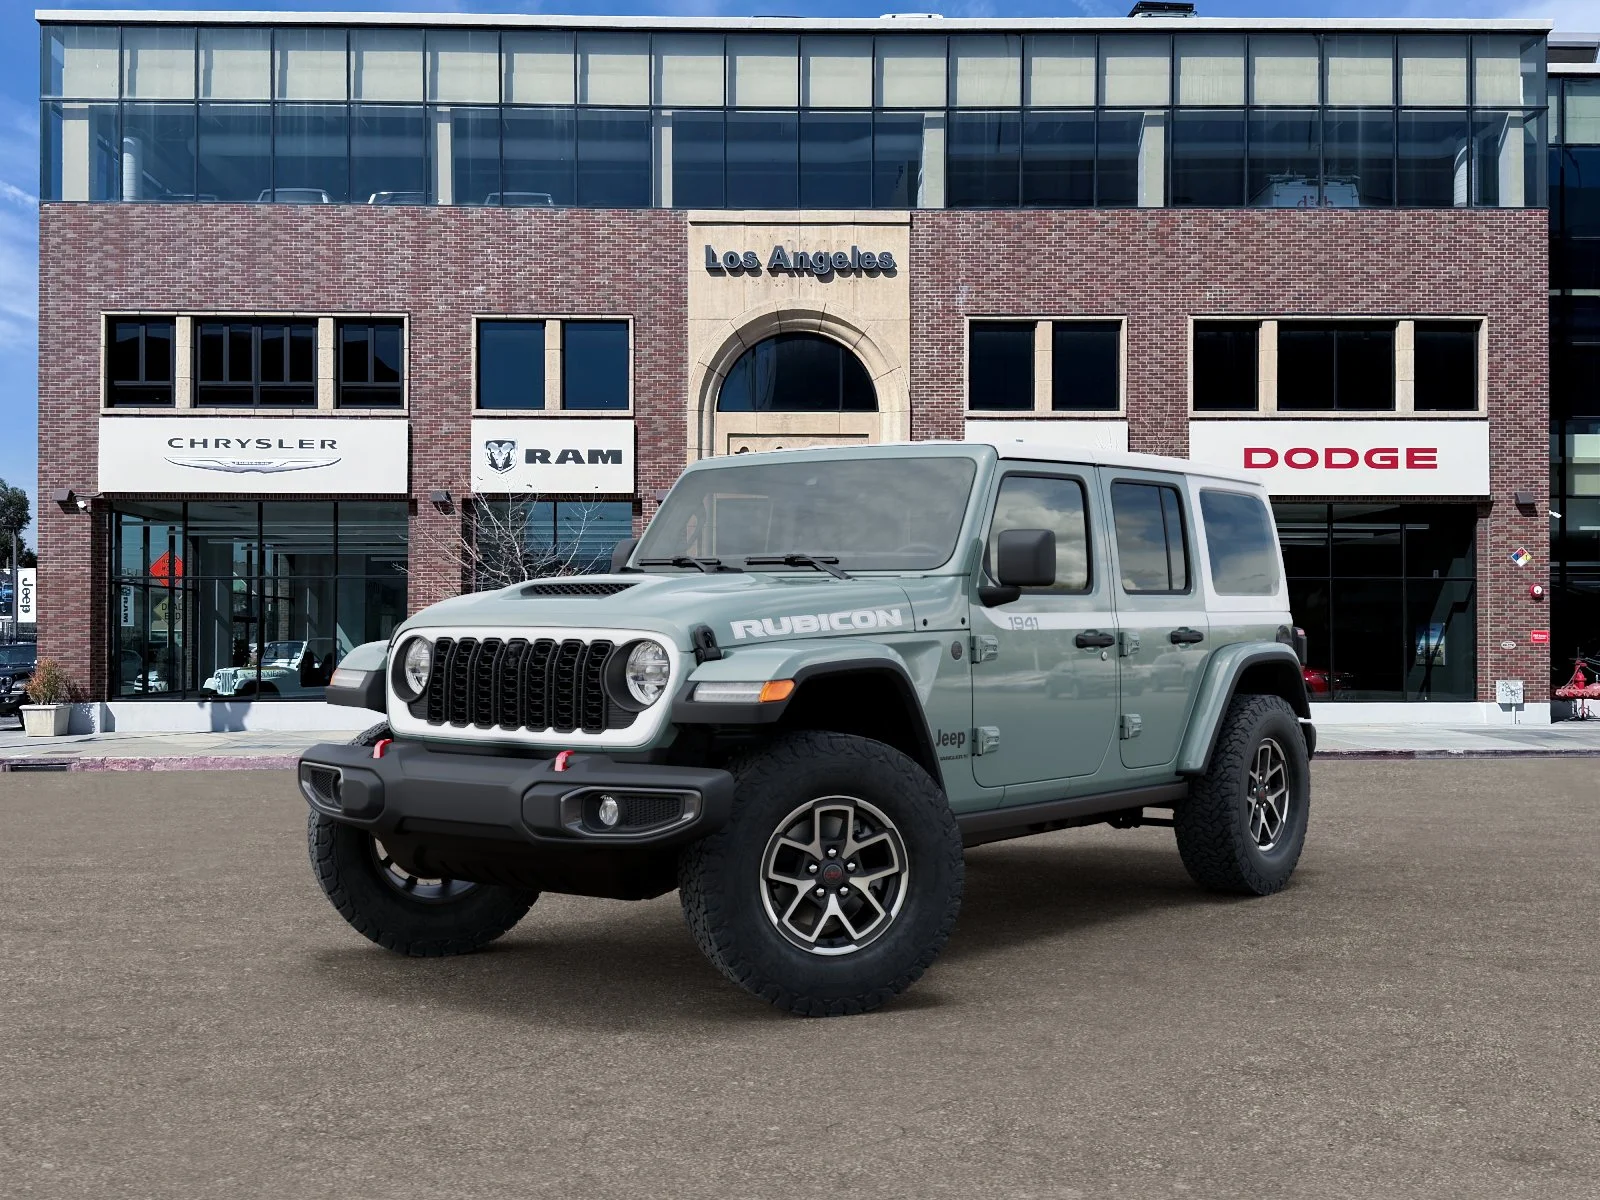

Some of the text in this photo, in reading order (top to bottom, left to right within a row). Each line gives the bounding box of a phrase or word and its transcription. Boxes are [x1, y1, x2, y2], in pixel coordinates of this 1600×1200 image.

[704, 245, 895, 275] Los Angeles
[167, 437, 338, 450] CHRYSLER
[525, 449, 623, 465] RAM
[1243, 447, 1438, 470] DODGE
[20, 577, 33, 613] Jeep
[165, 612, 181, 620] ED
[730, 608, 903, 640] RUBICON
[1008, 616, 1039, 630] 1941
[936, 729, 965, 748] Jeep
